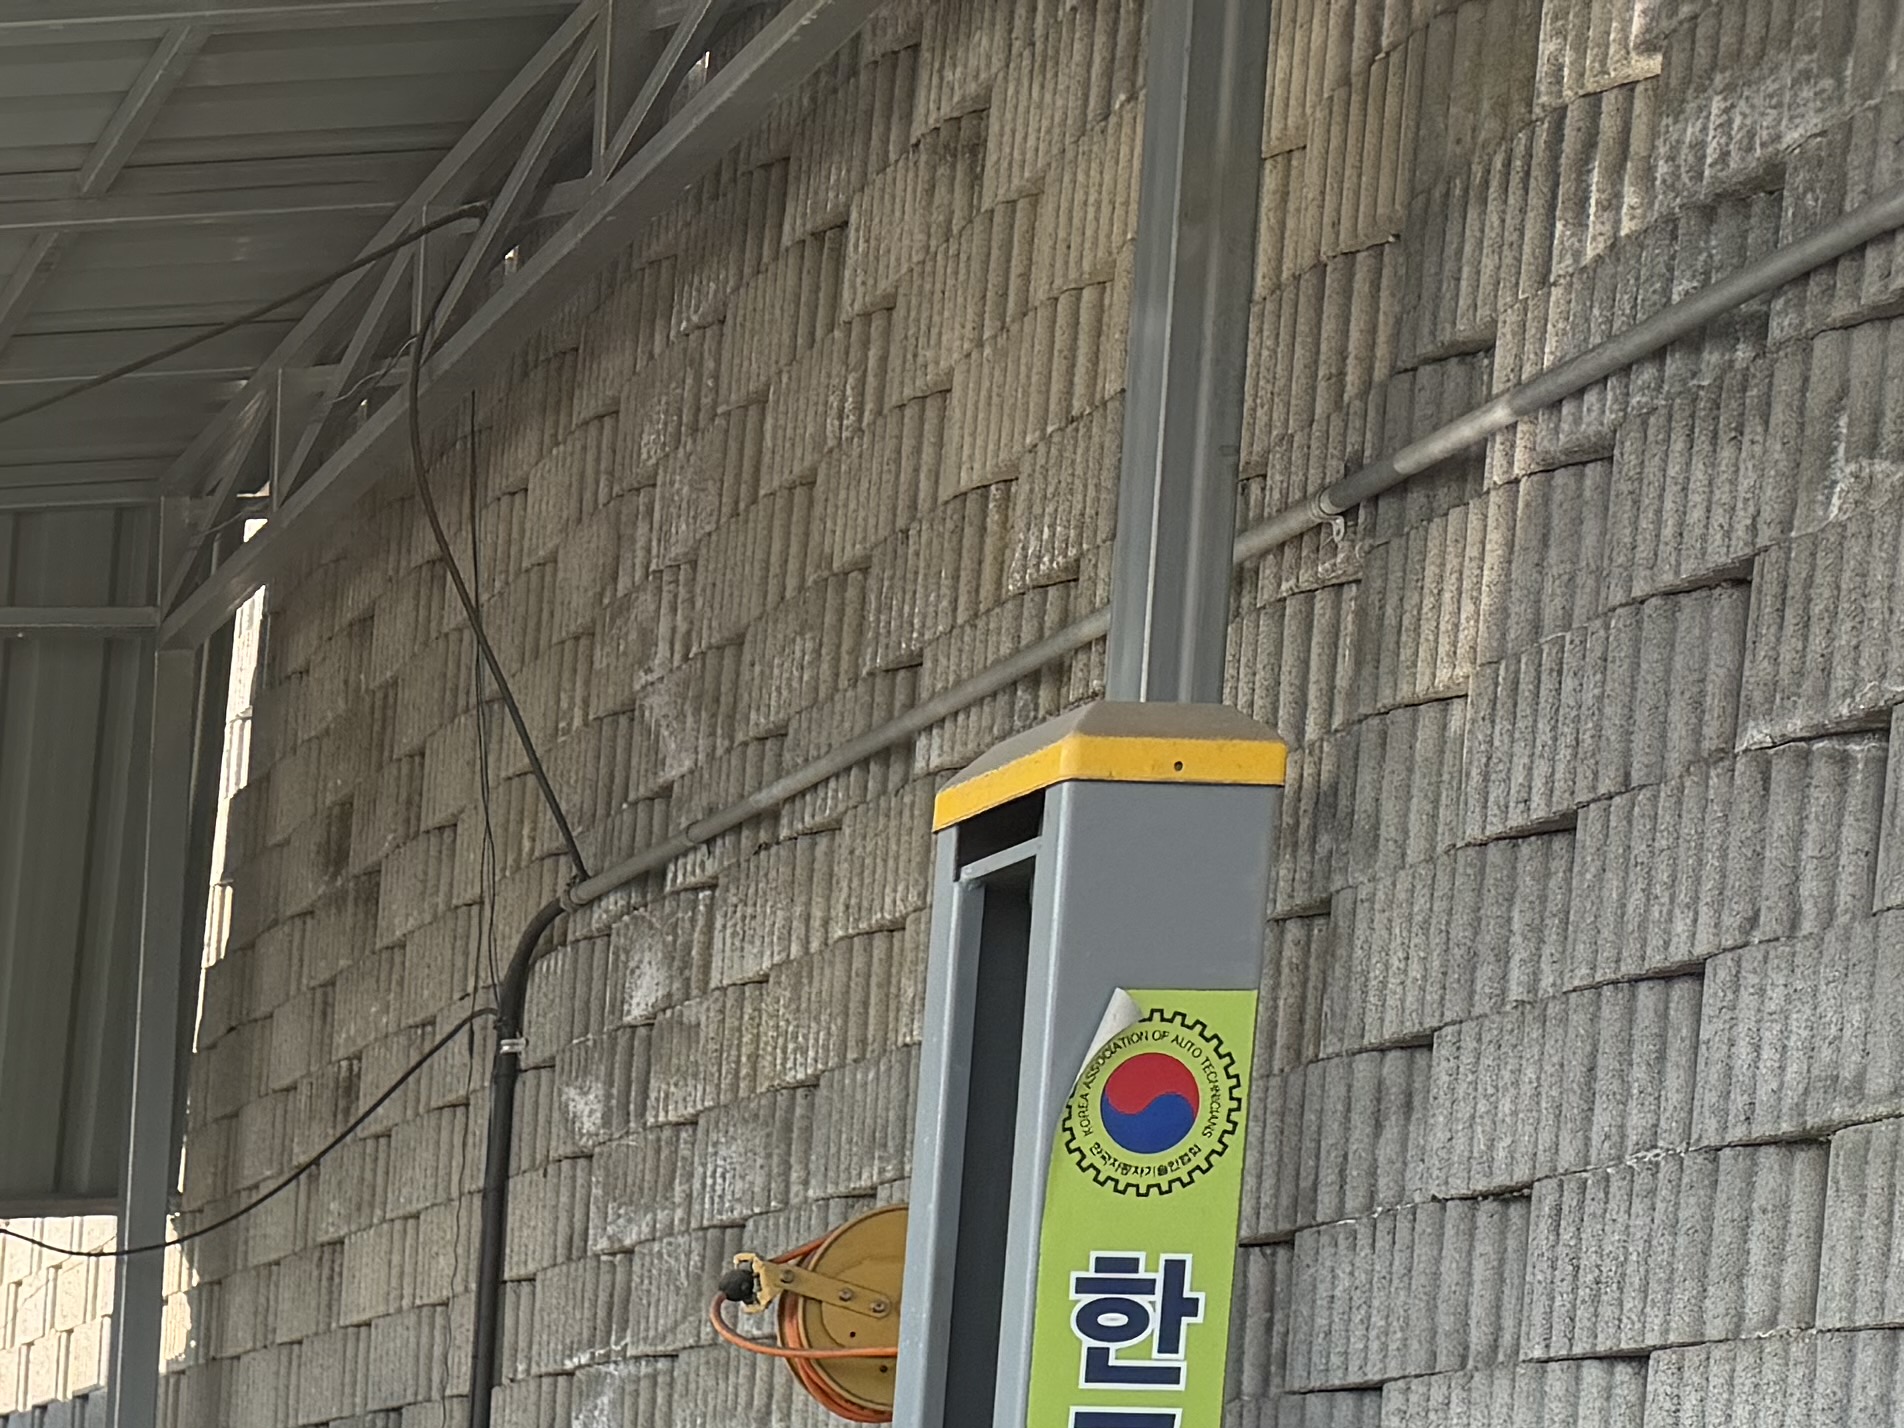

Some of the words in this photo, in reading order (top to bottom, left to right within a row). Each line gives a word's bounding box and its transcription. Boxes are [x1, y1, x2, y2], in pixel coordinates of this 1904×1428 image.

[1152, 1030, 1169, 1041] OF
[1171, 1035, 1202, 1058] AUTO
[1083, 1031, 1148, 1089] ASSOCIATION
[1078, 1093, 1093, 1136] KOREA
